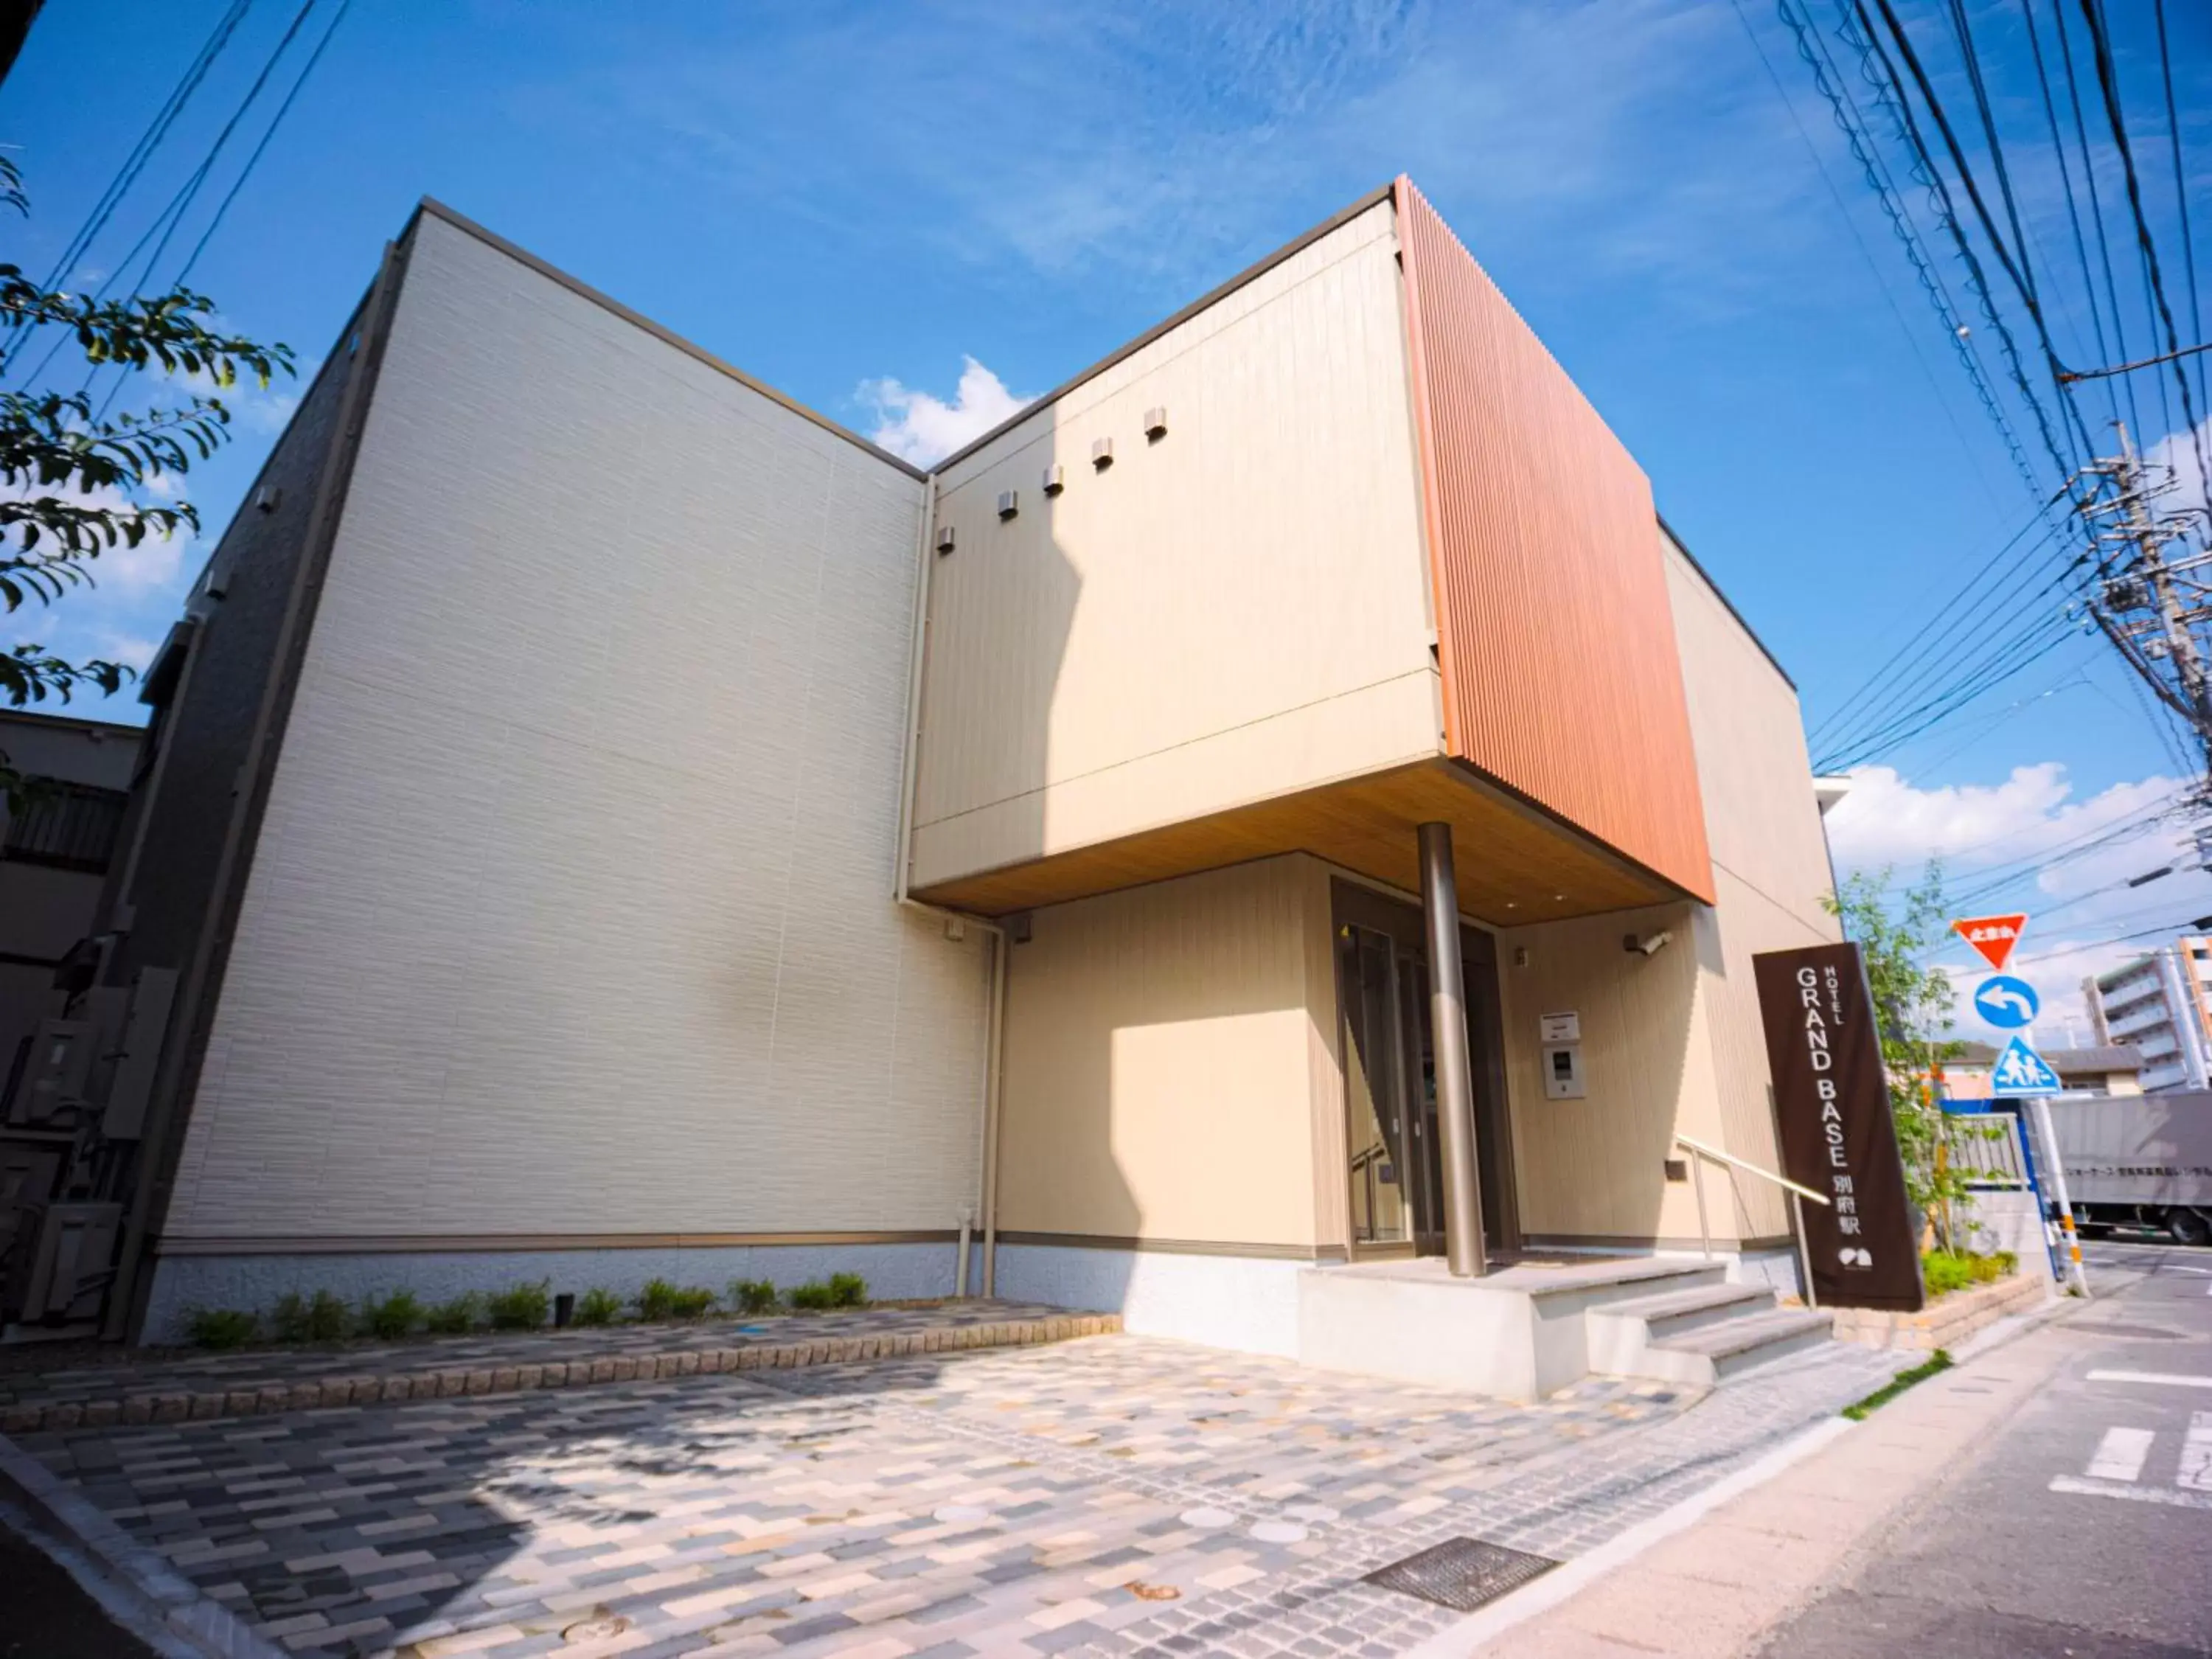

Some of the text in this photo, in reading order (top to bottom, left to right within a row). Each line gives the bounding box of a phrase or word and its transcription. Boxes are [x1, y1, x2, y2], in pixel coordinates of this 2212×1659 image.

[1823, 965, 1843, 1025] HOTEL
[1797, 967, 1832, 1071] GRAND
[1818, 1079, 1848, 1167] BASE
[1833, 1175, 1861, 1234] 別府駅
